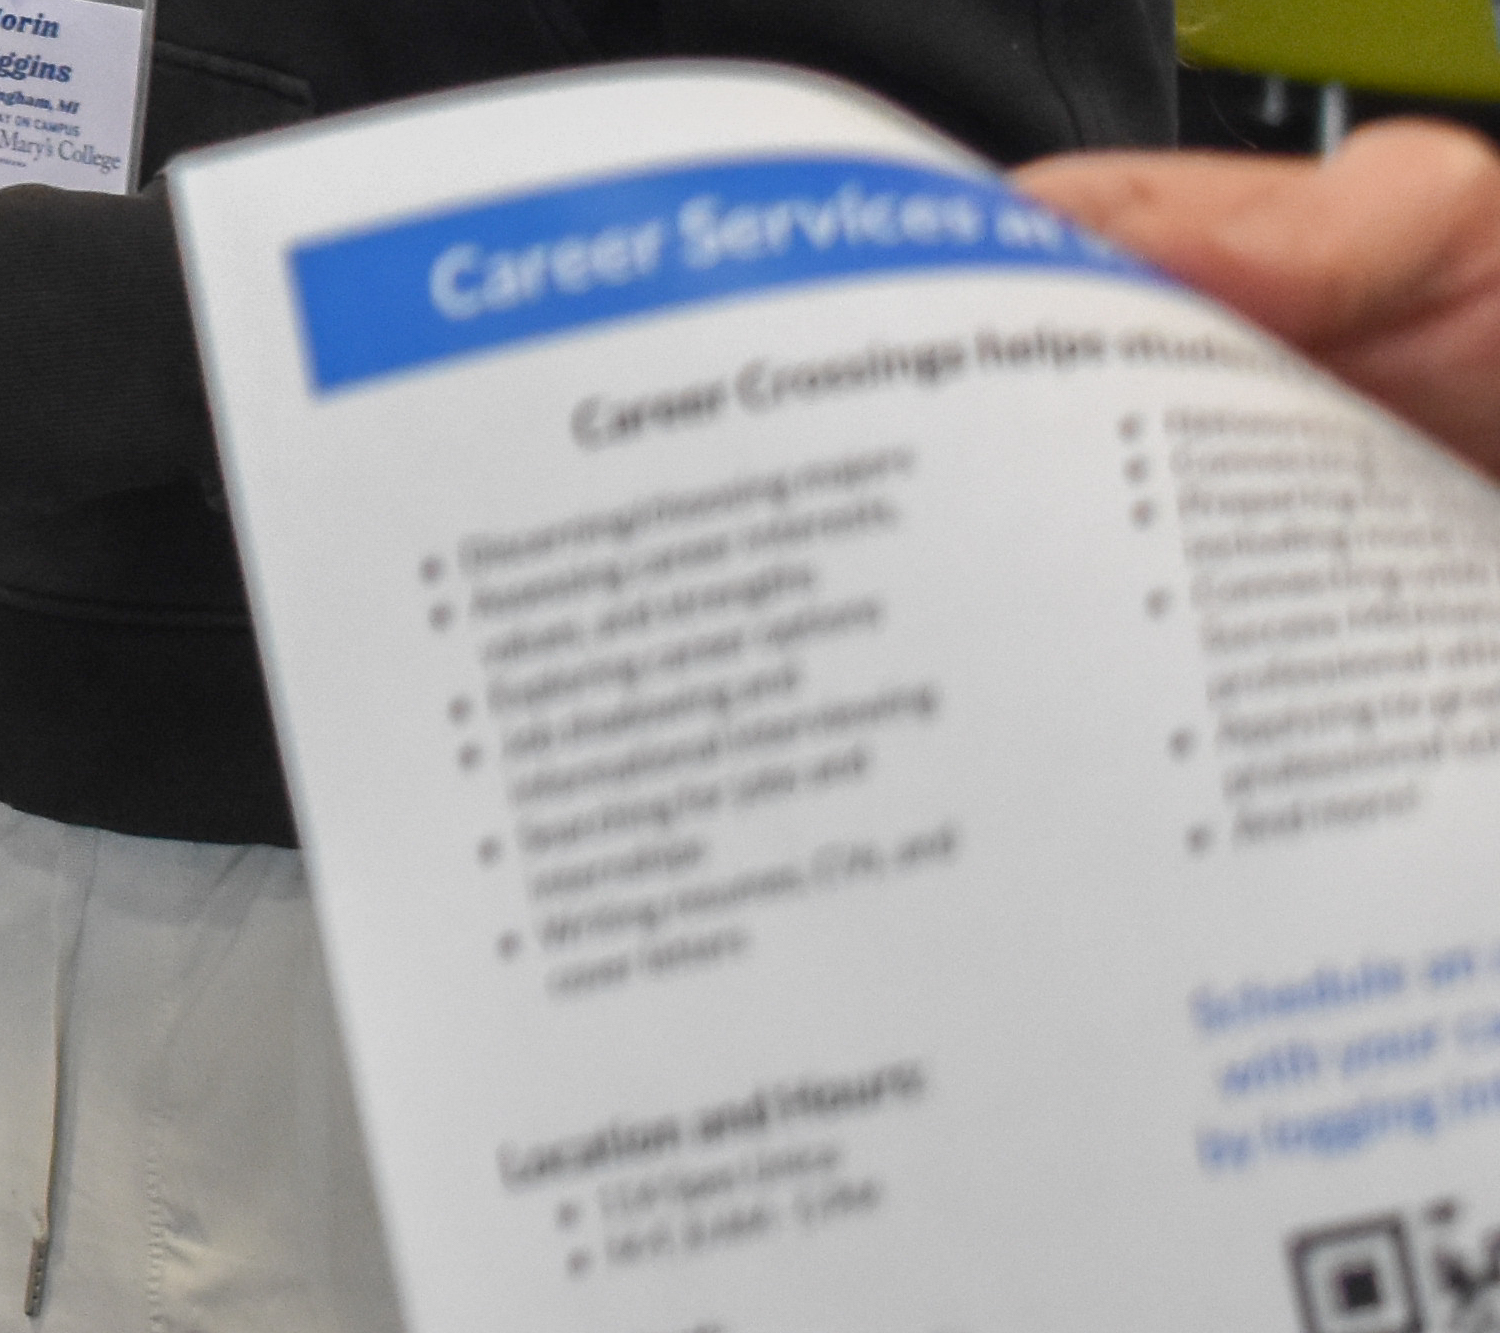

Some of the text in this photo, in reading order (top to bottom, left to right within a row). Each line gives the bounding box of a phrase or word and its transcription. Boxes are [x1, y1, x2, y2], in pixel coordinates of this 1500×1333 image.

[59, 99, 80, 115] MI
[57, 139, 122, 175] College
[428, 219, 664, 321] Career
[676, 182, 981, 270] Services
